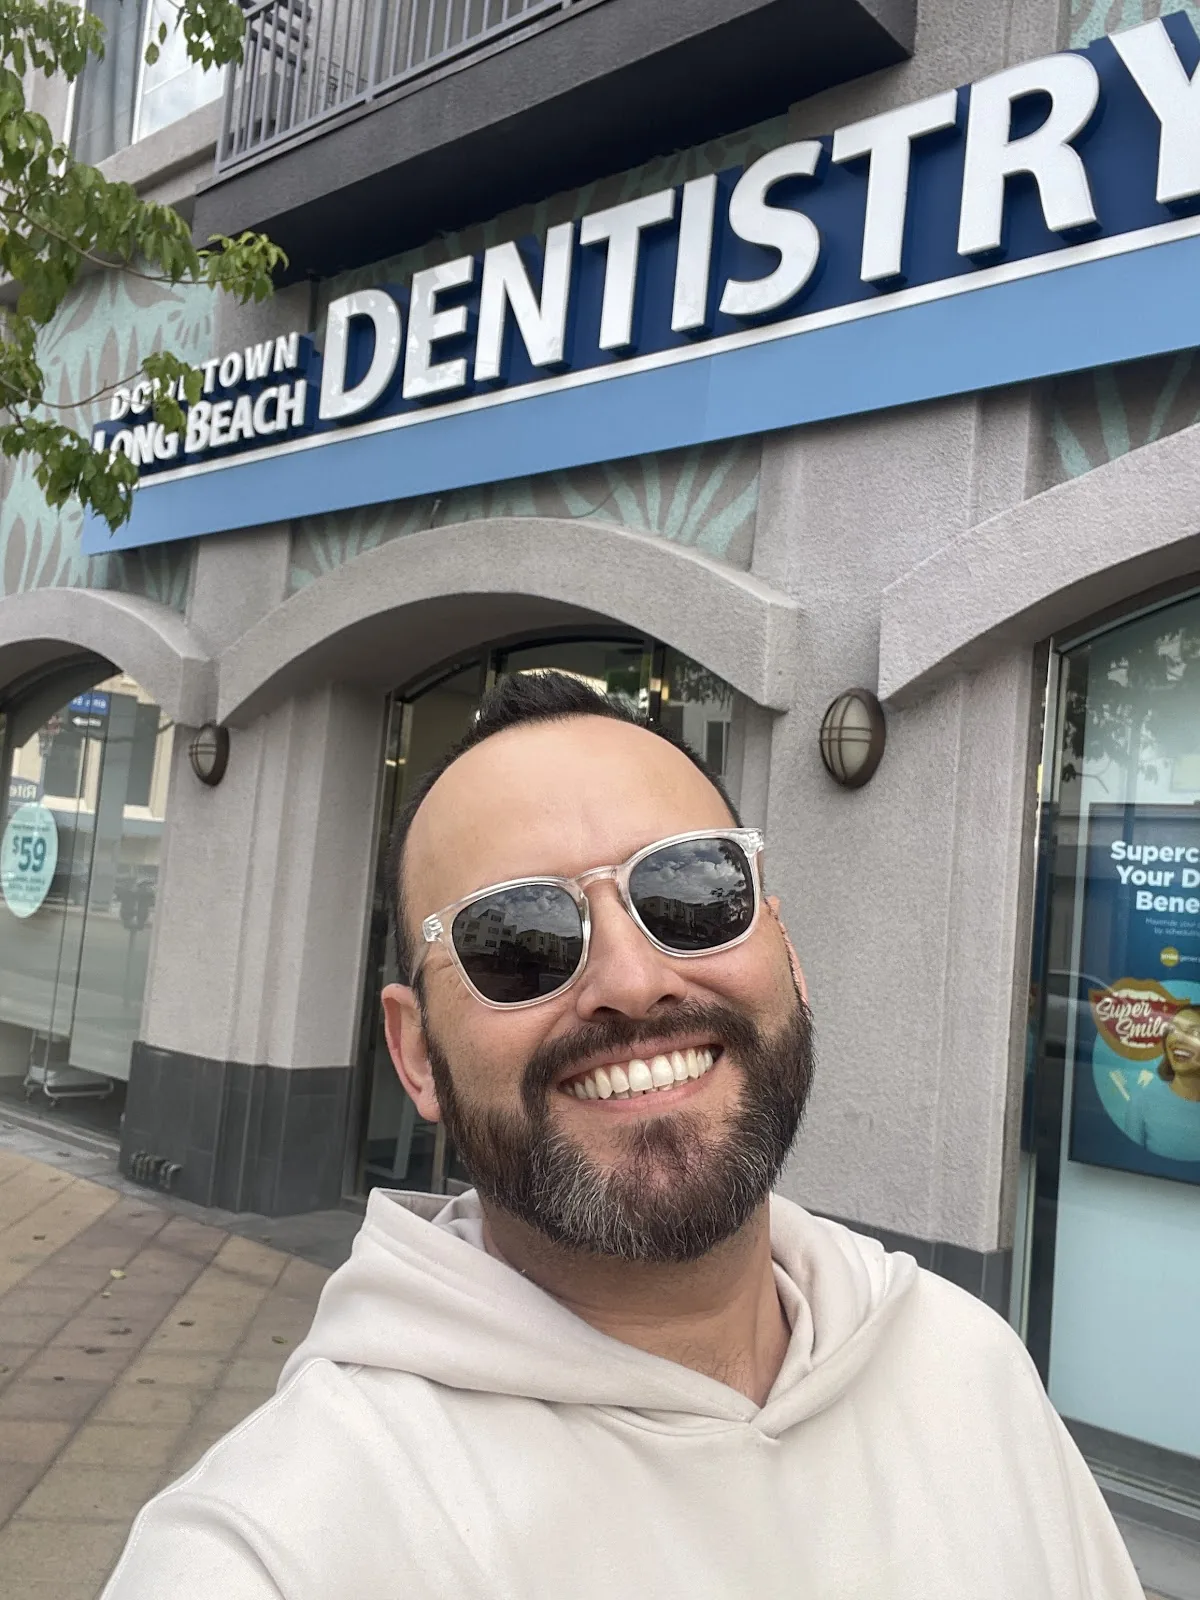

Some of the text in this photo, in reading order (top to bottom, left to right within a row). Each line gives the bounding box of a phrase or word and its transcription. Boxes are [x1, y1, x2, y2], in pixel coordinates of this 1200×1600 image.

[318, 17, 1200, 421] DENTISTRY
[184, 379, 307, 454] BEACH
[12, 835, 47, 872] $59
[1110, 840, 1200, 865] Superc
[1116, 864, 1200, 888] Your D
[1136, 890, 1200, 914] Bene
[1096, 997, 1152, 1021] Super
